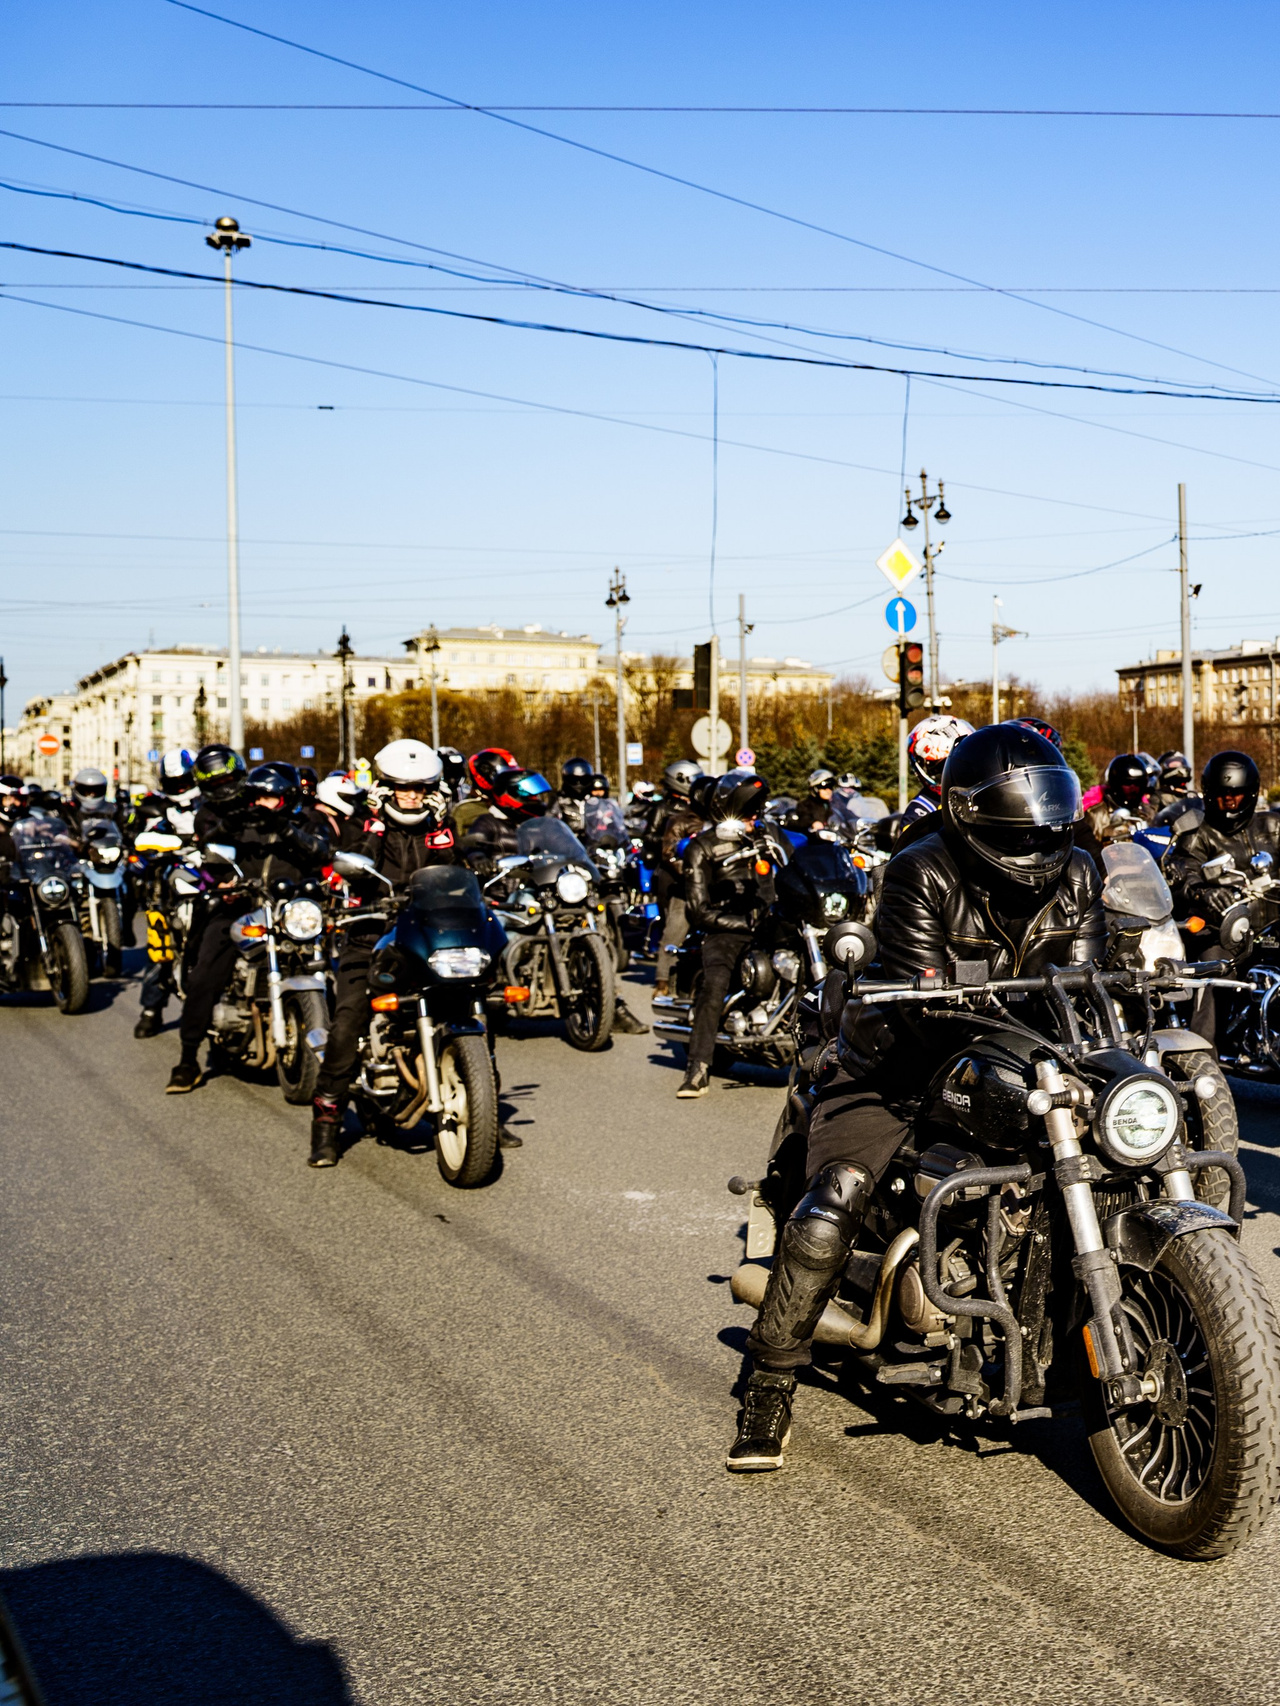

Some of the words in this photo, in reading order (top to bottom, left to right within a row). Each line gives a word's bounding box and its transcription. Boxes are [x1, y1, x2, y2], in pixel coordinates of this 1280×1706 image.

[1024, 803, 1061, 814] SARK
[942, 1089, 971, 1107] BENDA
[1112, 1117, 1138, 1126] BENDA
